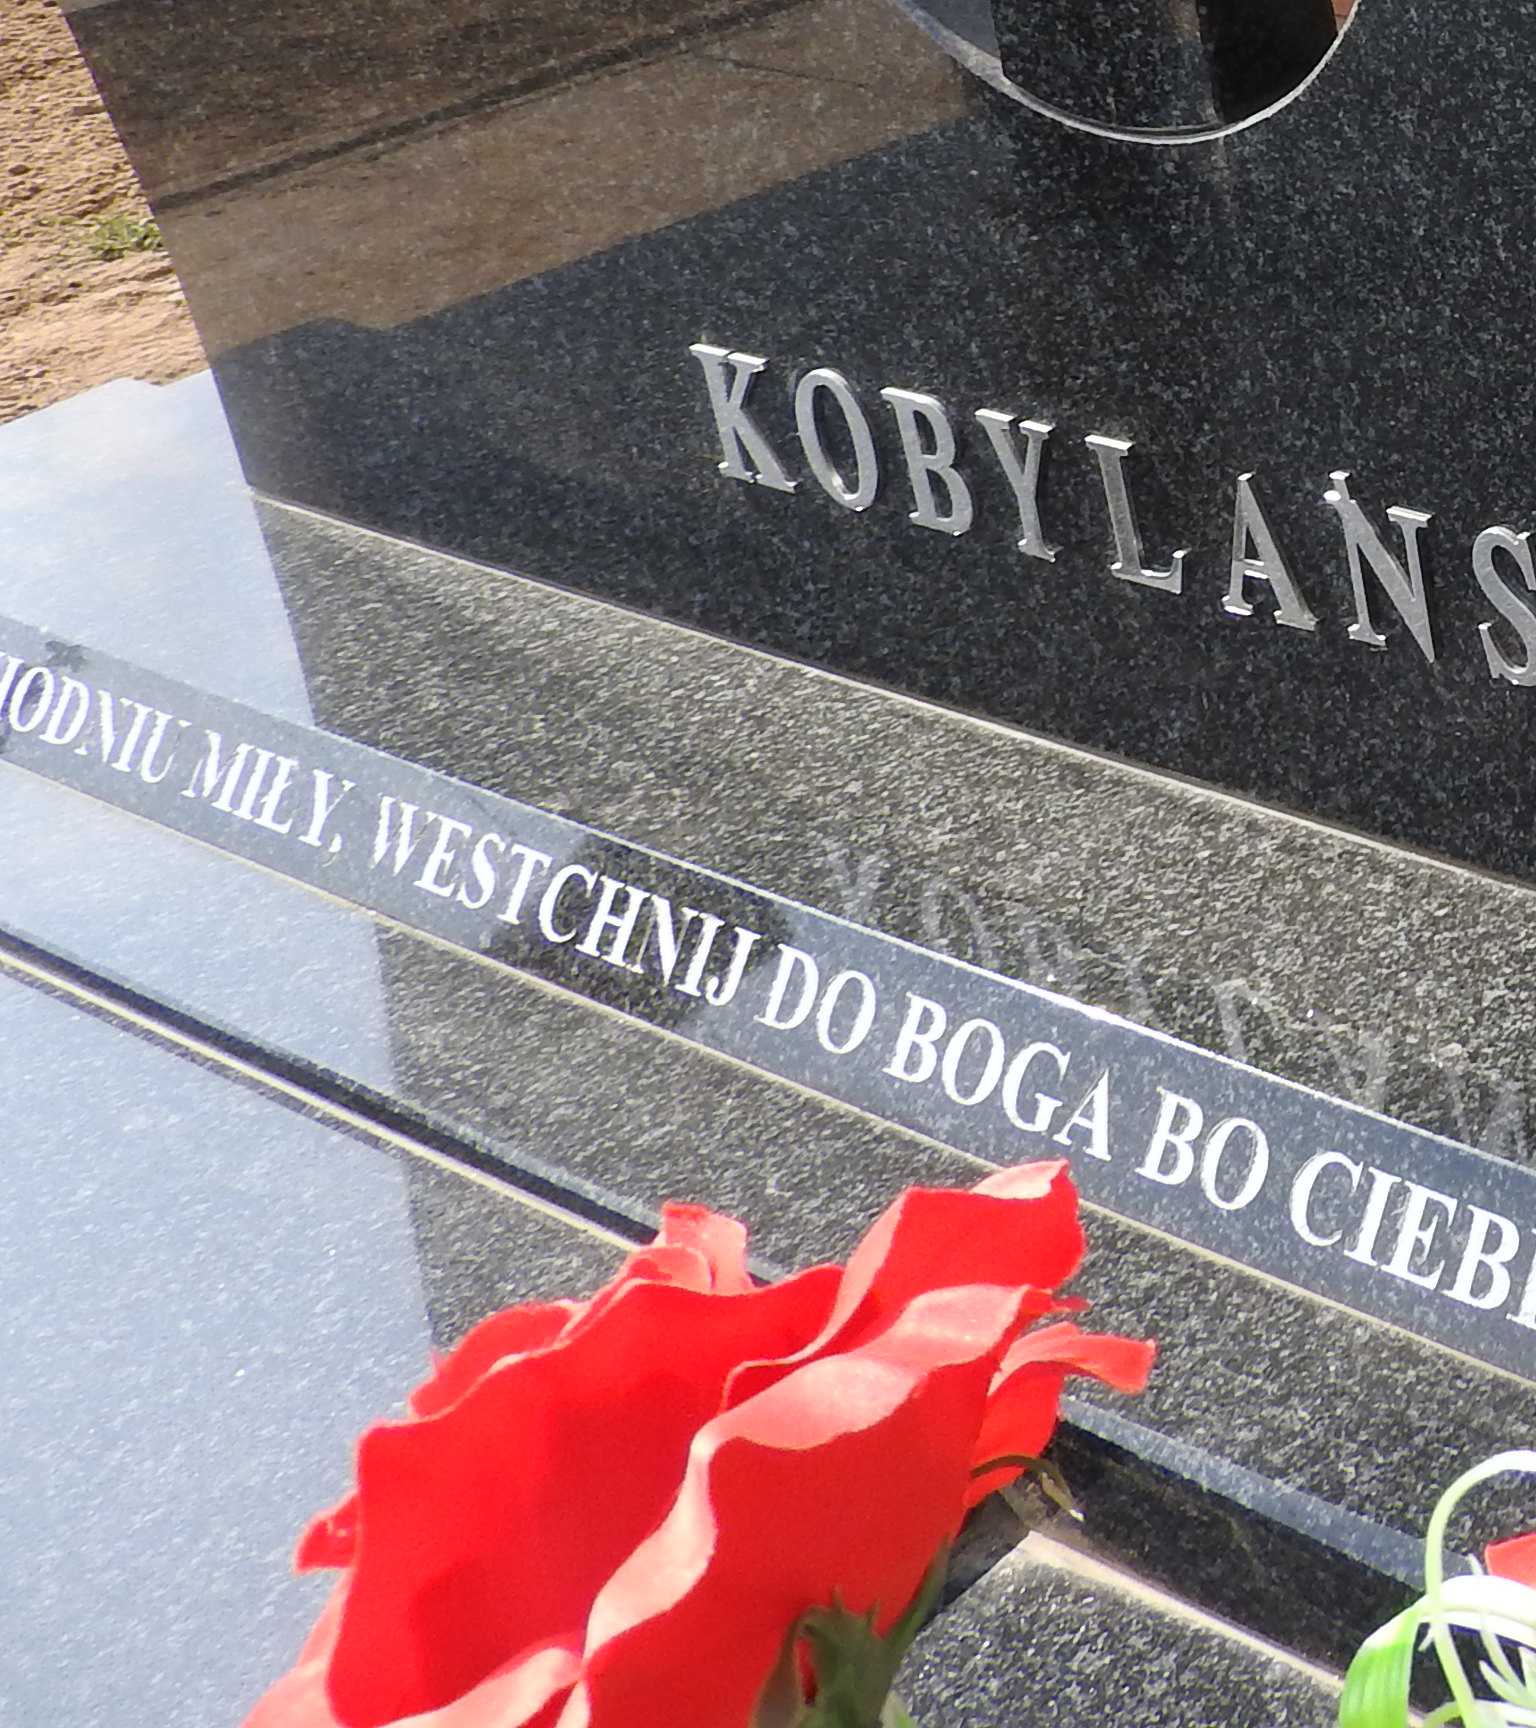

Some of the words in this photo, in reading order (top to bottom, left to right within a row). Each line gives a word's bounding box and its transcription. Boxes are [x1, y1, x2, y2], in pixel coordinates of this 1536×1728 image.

[180, 731, 356, 854] MIŁY,
[370, 796, 762, 1006] WESTCHNIJ
[755, 943, 877, 1056] DO
[882, 992, 1116, 1160] BOGA
[1136, 1085, 1272, 1211] BO
